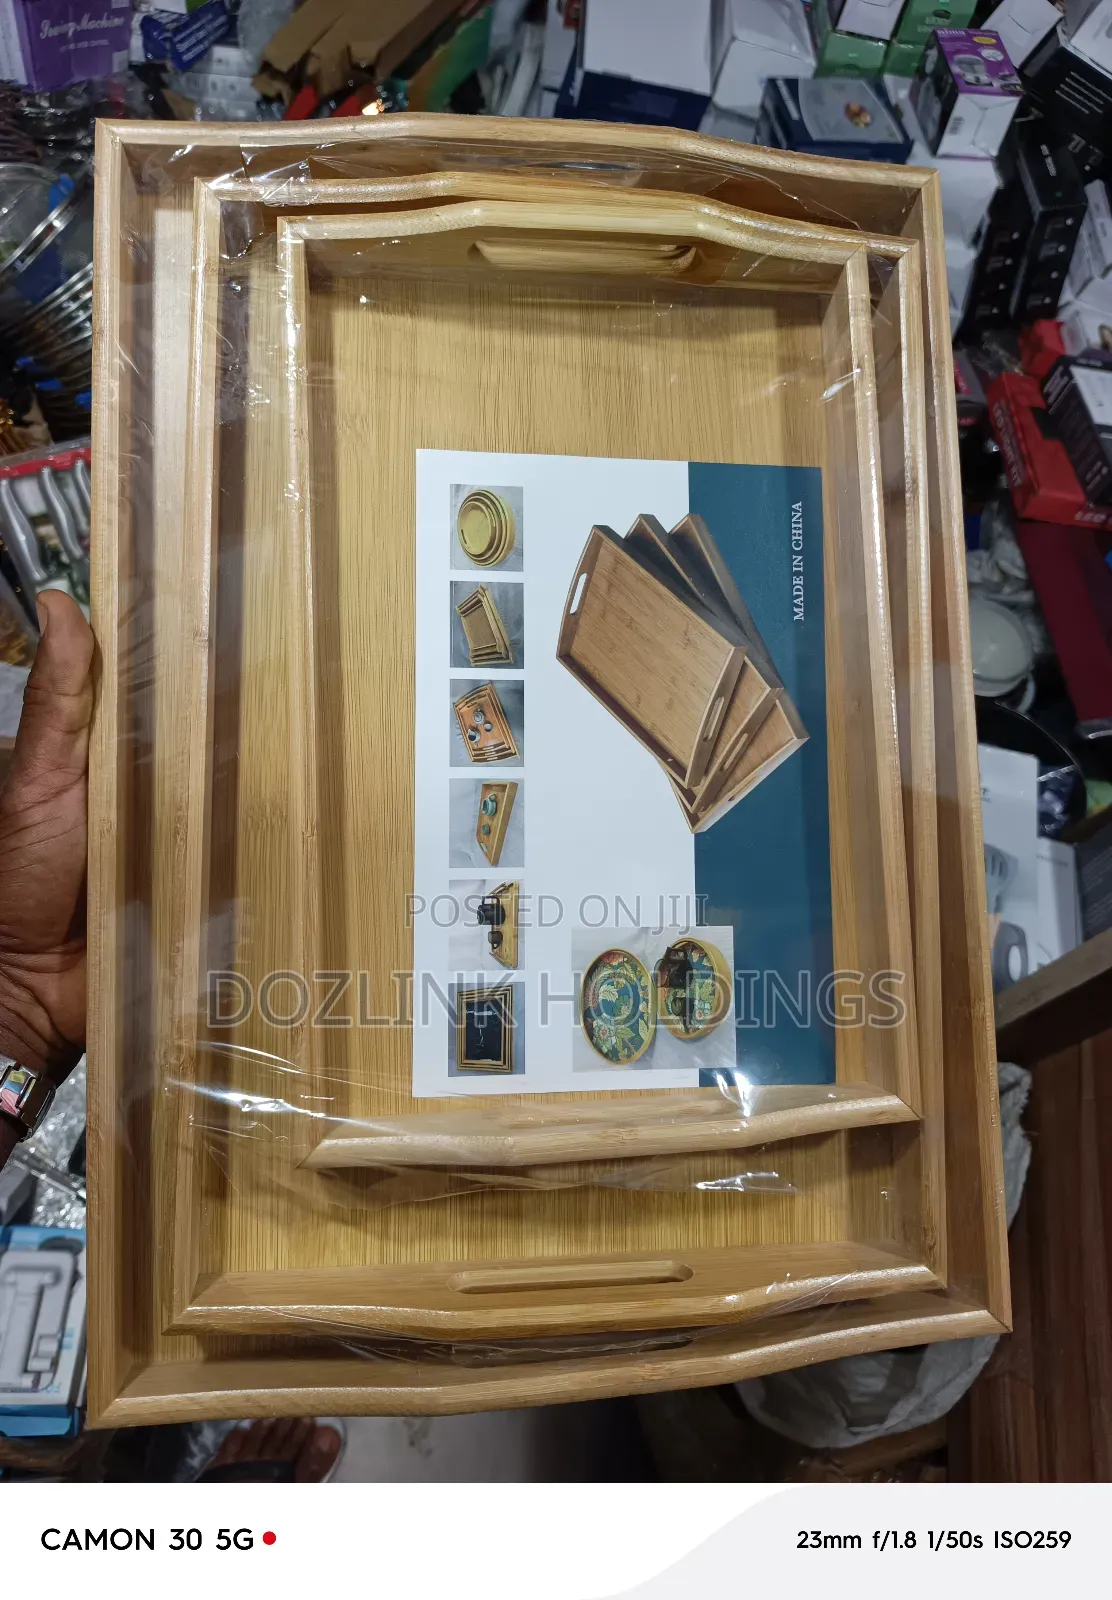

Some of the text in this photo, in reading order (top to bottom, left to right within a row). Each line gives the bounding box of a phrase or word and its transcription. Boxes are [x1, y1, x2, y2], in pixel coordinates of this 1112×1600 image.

[791, 501, 805, 621] MADE IN CHINA
